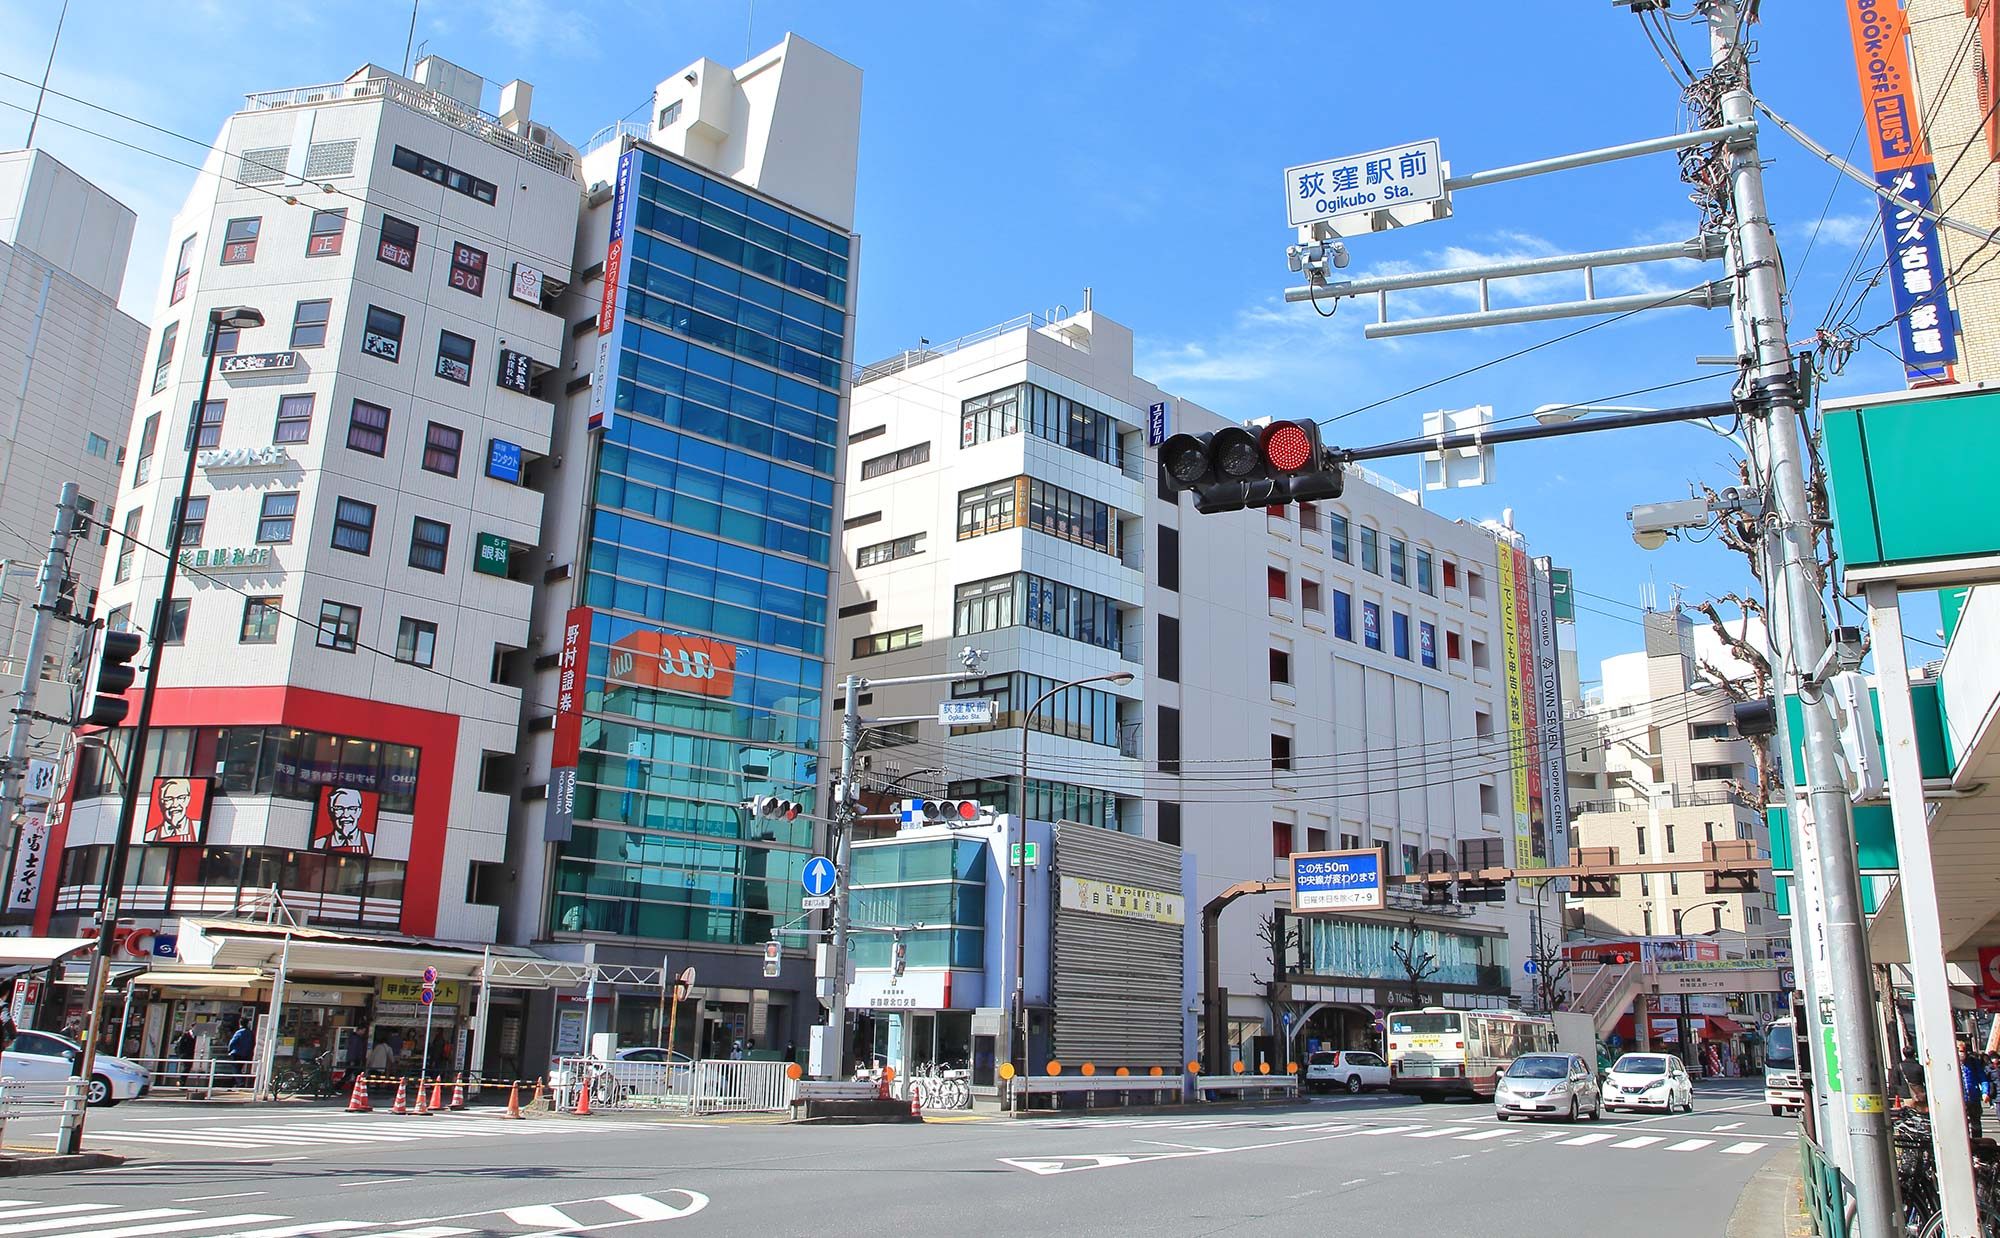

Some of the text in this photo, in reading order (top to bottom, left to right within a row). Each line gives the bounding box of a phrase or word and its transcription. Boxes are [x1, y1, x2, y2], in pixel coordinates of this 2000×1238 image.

[1298, 150, 1427, 199] 荻窪駅前
[1316, 184, 1414, 213] Ogikubo Sta.
[317, 236, 334, 252] 正
[382, 243, 411, 266] 歯な
[458, 248, 483, 267] 8F
[453, 270, 479, 290] らび
[367, 336, 396, 356] 武田
[491, 451, 520, 467] コンタクト
[493, 537, 507, 547] 5F
[481, 545, 507, 563] 眼科
[1364, 610, 1374, 627] 本
[1421, 630, 1430, 646] 本
[1540, 610, 1550, 647] OGIKUBO
[943, 701, 987, 714] 荻窪駅前
[1544, 673, 1558, 750] TOWN SEVEN
[948, 714, 968, 722] Ogikubo
[555, 771, 564, 815] NOMURA
[564, 770, 576, 815] NOMURA
[1551, 760, 1562, 835] SHOPPING CENTER
[17, 833, 41, 904] 富士そば
[1297, 862, 1350, 874] この先50m
[1297, 871, 1377, 886] 中央線が変わります
[387, 983, 454, 998] 甲南チット
